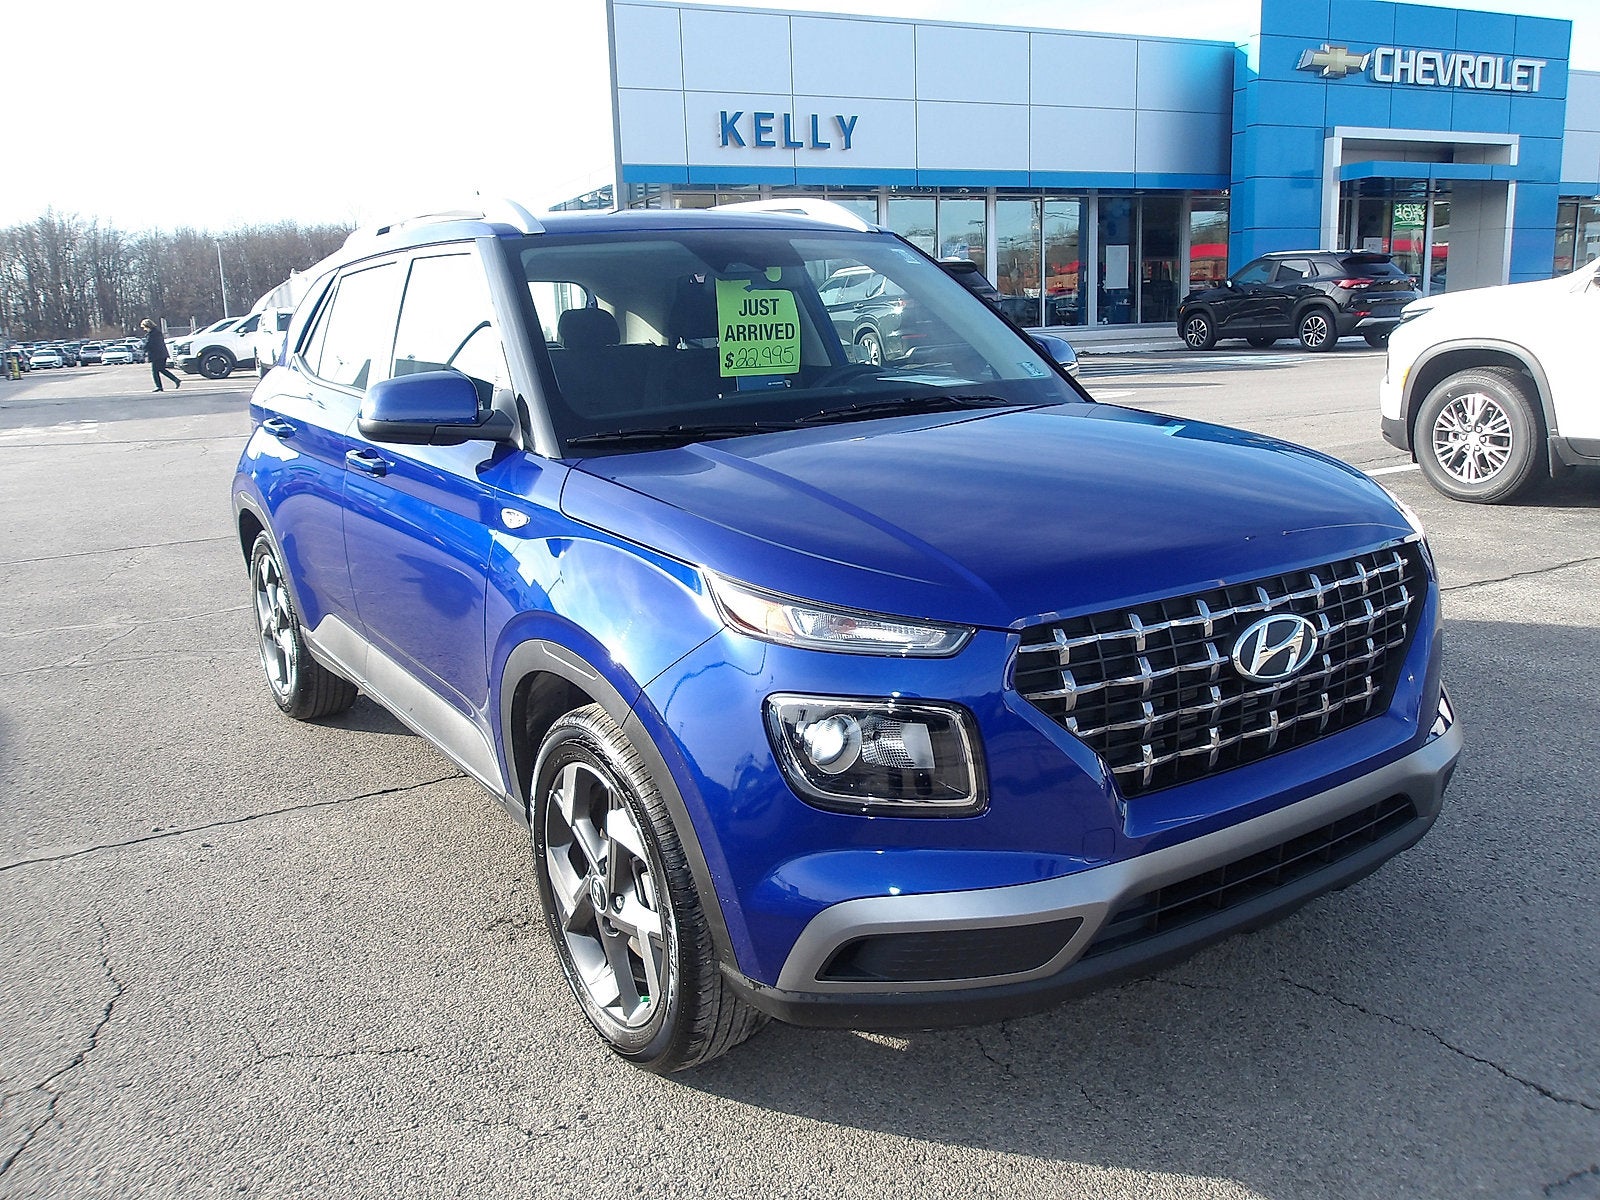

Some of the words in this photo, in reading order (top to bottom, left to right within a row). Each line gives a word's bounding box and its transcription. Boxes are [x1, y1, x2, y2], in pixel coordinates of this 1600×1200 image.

[1373, 47, 1547, 93] CHEVROLET
[719, 110, 859, 151] KELLY
[739, 298, 780, 317] JUST
[724, 322, 796, 342] ARRIVED
